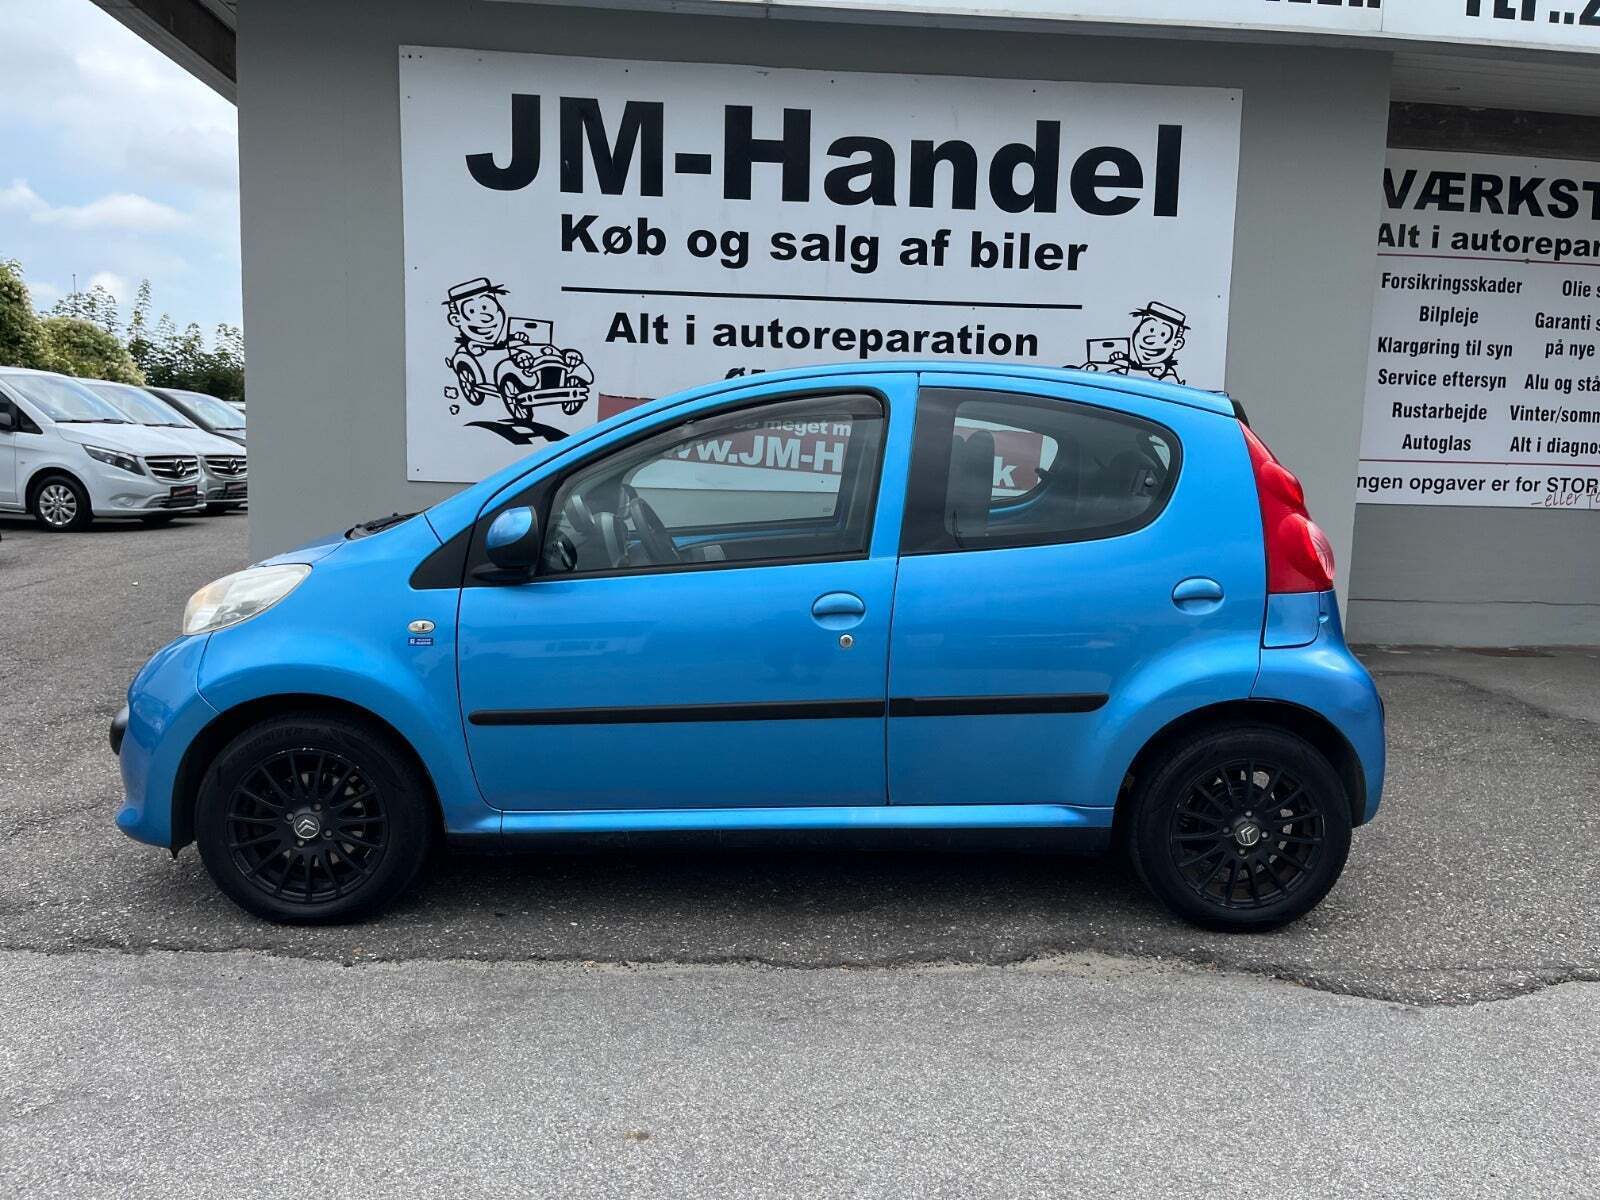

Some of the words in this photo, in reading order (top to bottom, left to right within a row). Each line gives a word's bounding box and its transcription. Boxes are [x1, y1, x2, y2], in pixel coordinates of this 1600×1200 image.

[465, 93, 1182, 217] JM-Handel
[561, 213, 667, 257] Køb
[687, 229, 750, 270] og
[770, 224, 880, 275] salg
[899, 228, 952, 267] af
[970, 230, 1089, 271] biler
[1378, 222, 1421, 249] Alt
[1432, 224, 1440, 249] i
[1381, 272, 1523, 295] Forsikringsskader
[1562, 279, 1592, 298] Olie
[1419, 305, 1479, 327] Bilpleje
[1535, 312, 1592, 331] Garanti
[605, 312, 669, 345] Alt
[686, 314, 696, 345] i
[713, 317, 1039, 359] autoreparation
[1377, 336, 1460, 359] Klargøring
[1465, 339, 1482, 356] til
[1486, 343, 1513, 360] syn
[1545, 338, 1564, 359] på
[1569, 343, 1596, 361] nye
[1378, 368, 1437, 386] Service
[1442, 370, 1507, 392] eftersyn
[1524, 373, 1549, 390] Alu
[1554, 378, 1572, 395] og
[1392, 401, 1488, 423] Rustarbejde
[1401, 433, 1472, 454] Autoglas
[1509, 436, 1532, 453] Alt
[1537, 436, 1542, 453] i
[1547, 437, 1600, 458] diagno
[1410, 476, 1486, 495] opgaver
[1491, 479, 1510, 493] er
[1516, 475, 1542, 493] for
